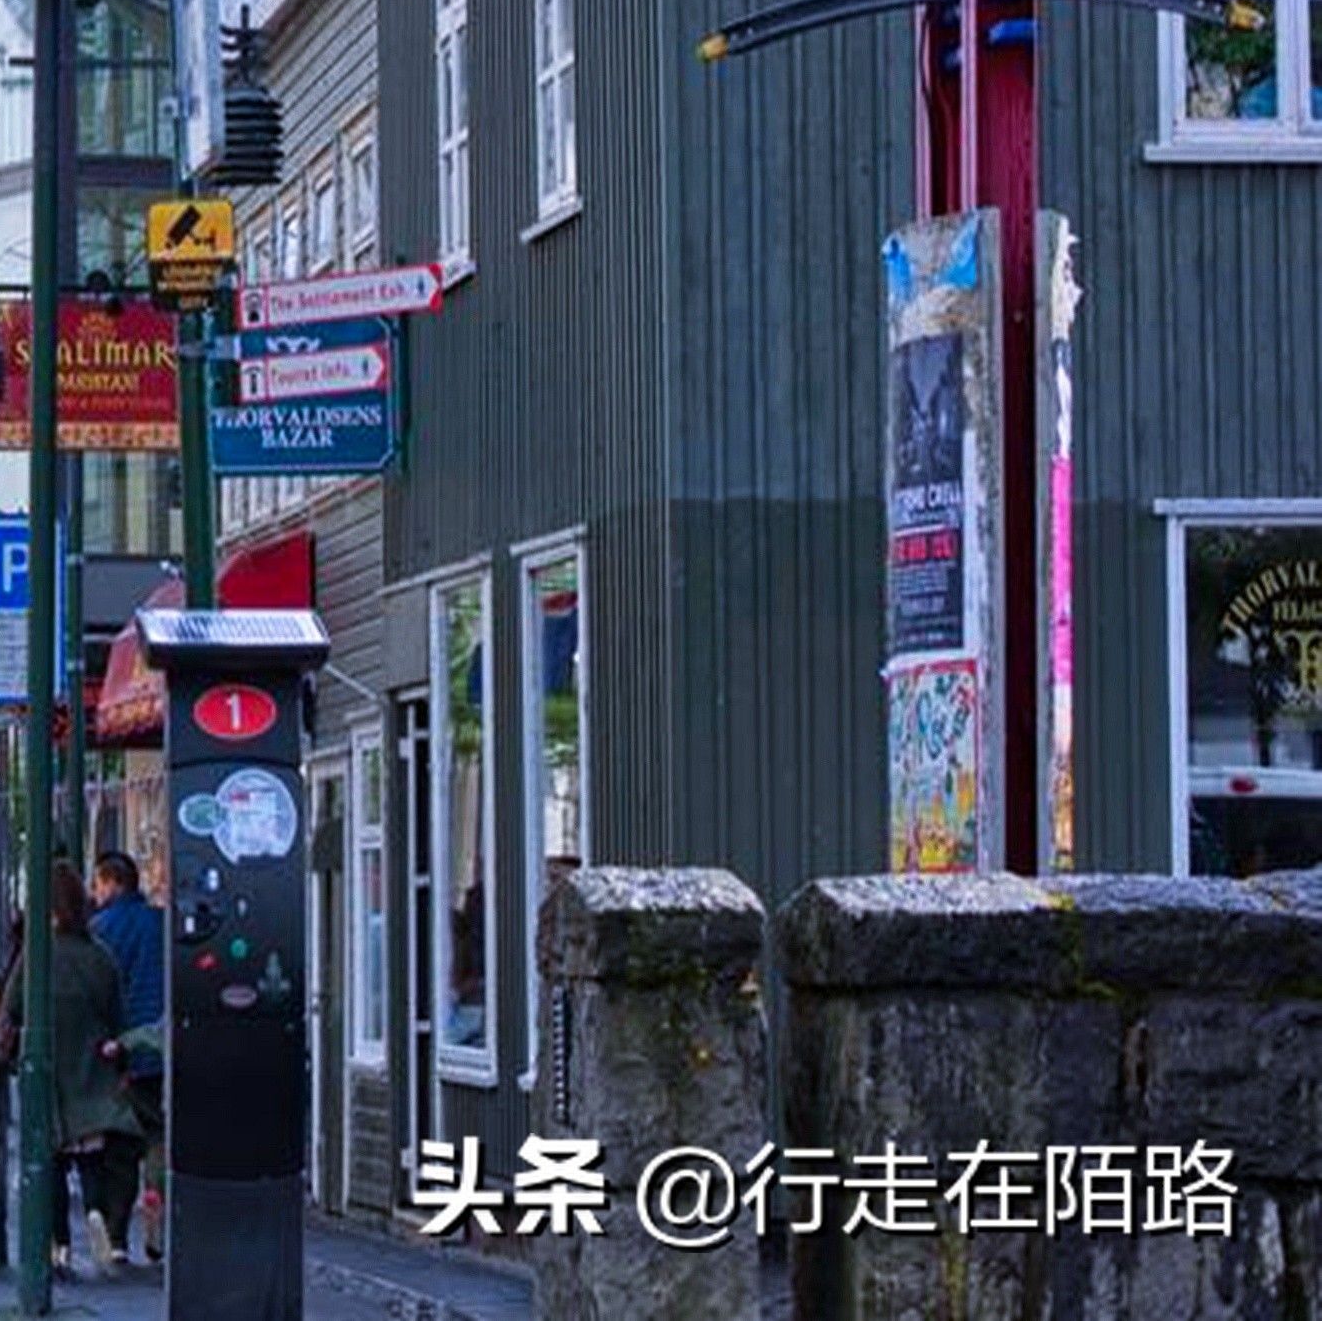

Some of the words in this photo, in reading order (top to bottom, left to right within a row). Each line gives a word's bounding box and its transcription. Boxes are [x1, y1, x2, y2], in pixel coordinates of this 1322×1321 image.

[15, 339, 178, 370] SALIMAR
[261, 428, 336, 448] BAZAR
[3, 542, 30, 593] P
[225, 693, 244, 732] 1
